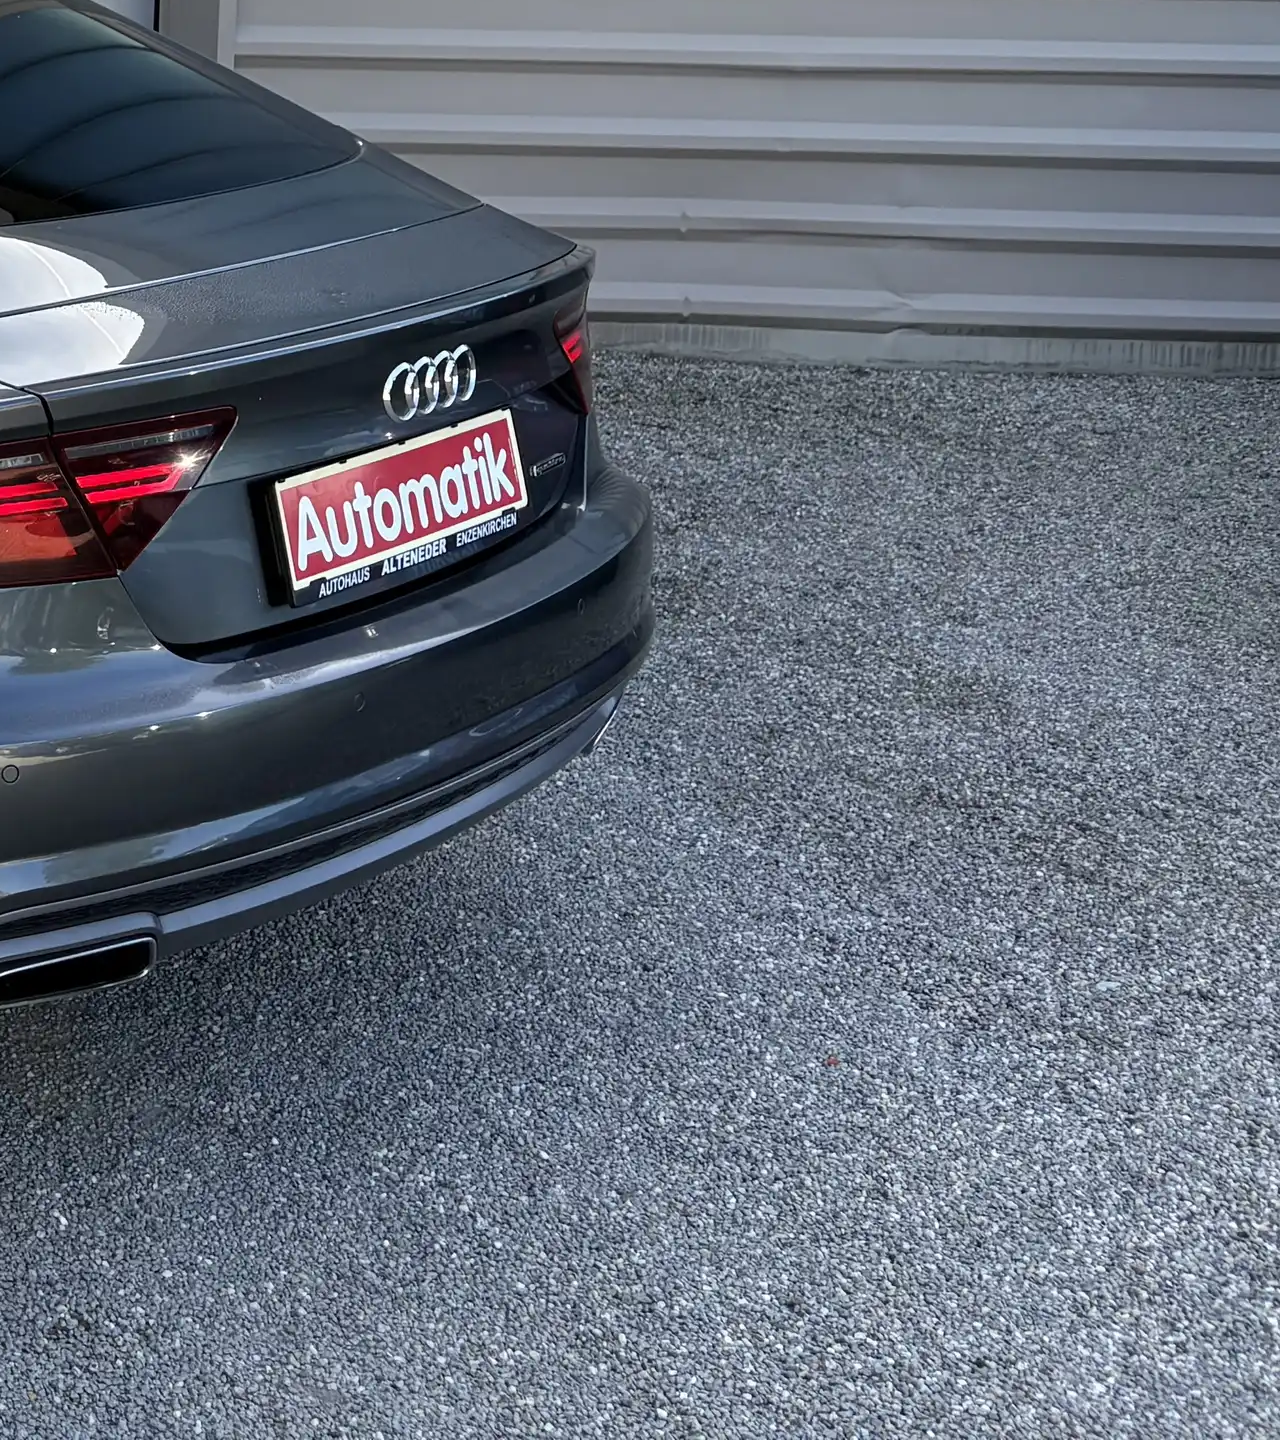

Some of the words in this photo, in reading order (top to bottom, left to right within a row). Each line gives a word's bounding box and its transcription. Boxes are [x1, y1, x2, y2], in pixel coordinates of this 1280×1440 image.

[296, 431, 515, 573] Automatik
[318, 566, 371, 599] AUTOHAUS
[381, 537, 447, 577] ALTENEDER
[456, 511, 517, 548] ENZENKIRCHEN
